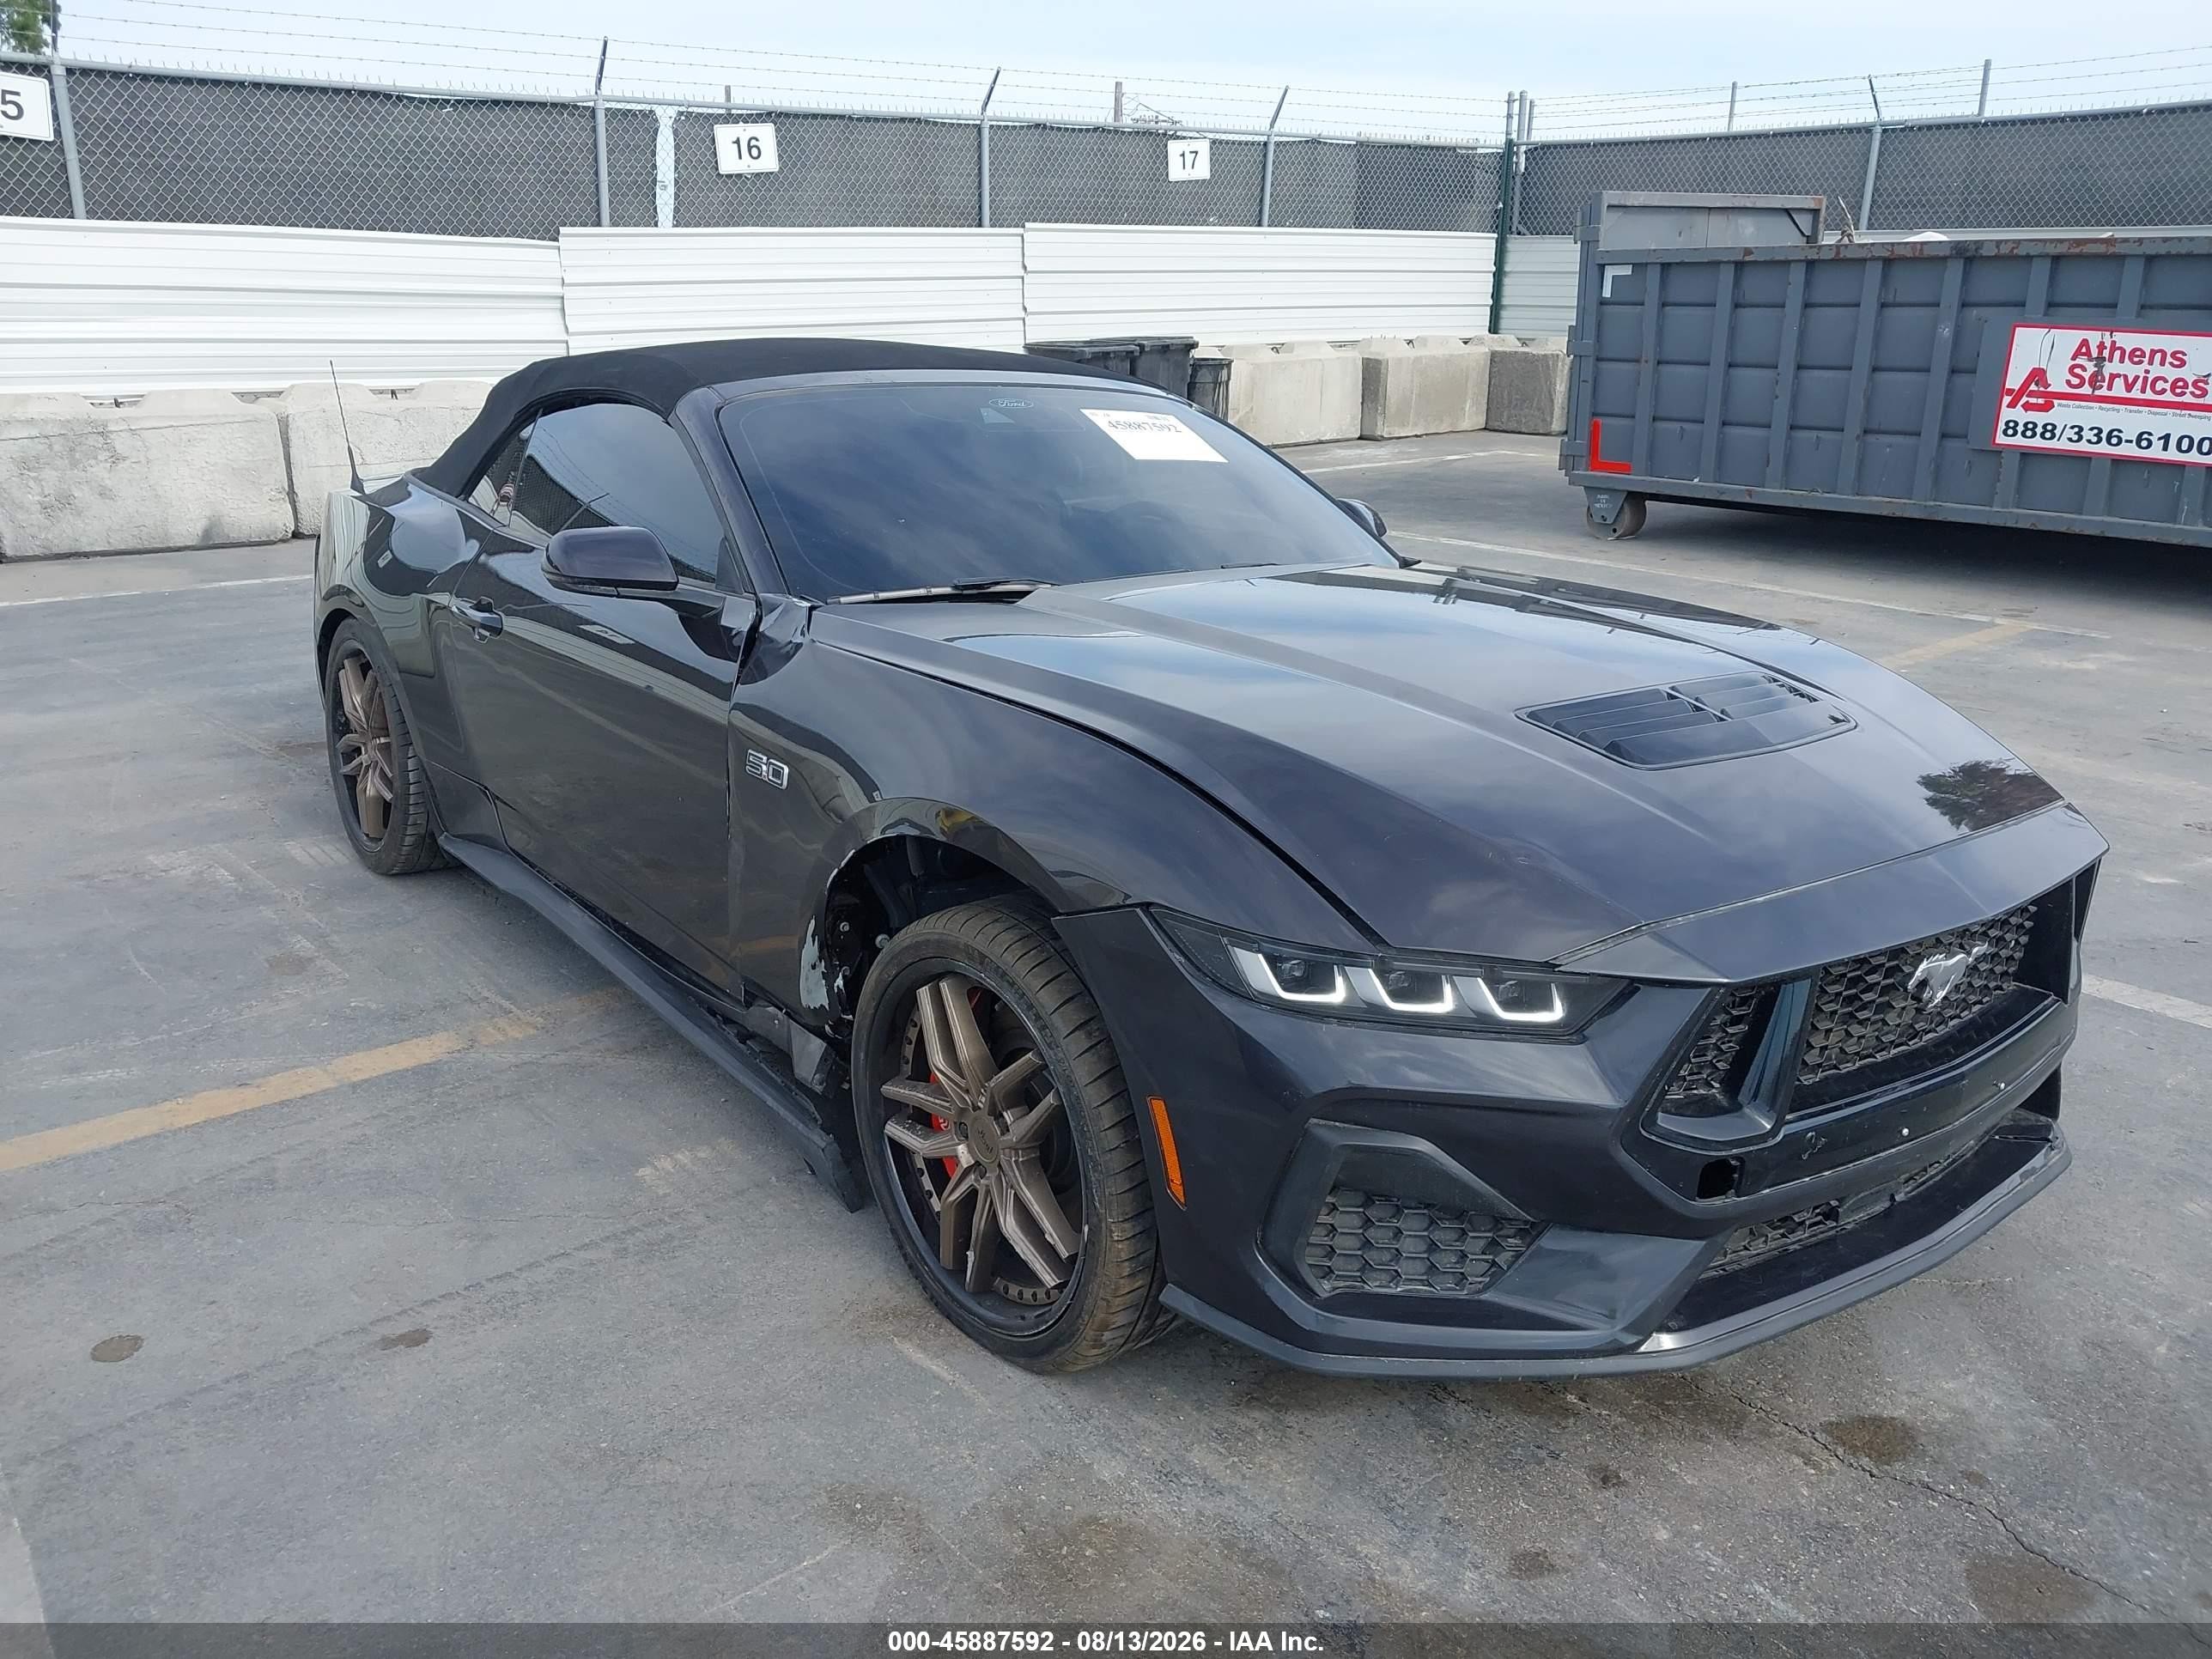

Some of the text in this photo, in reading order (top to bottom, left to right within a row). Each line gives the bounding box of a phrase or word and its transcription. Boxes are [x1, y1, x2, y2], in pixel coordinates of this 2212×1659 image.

[0, 88, 24, 121] 5
[732, 136, 762, 161] 16
[1179, 150, 1199, 170] 17
[2070, 337, 2188, 369] Athens
[2065, 363, 2209, 398] Services
[2002, 419, 2212, 456] 888/336-6100
